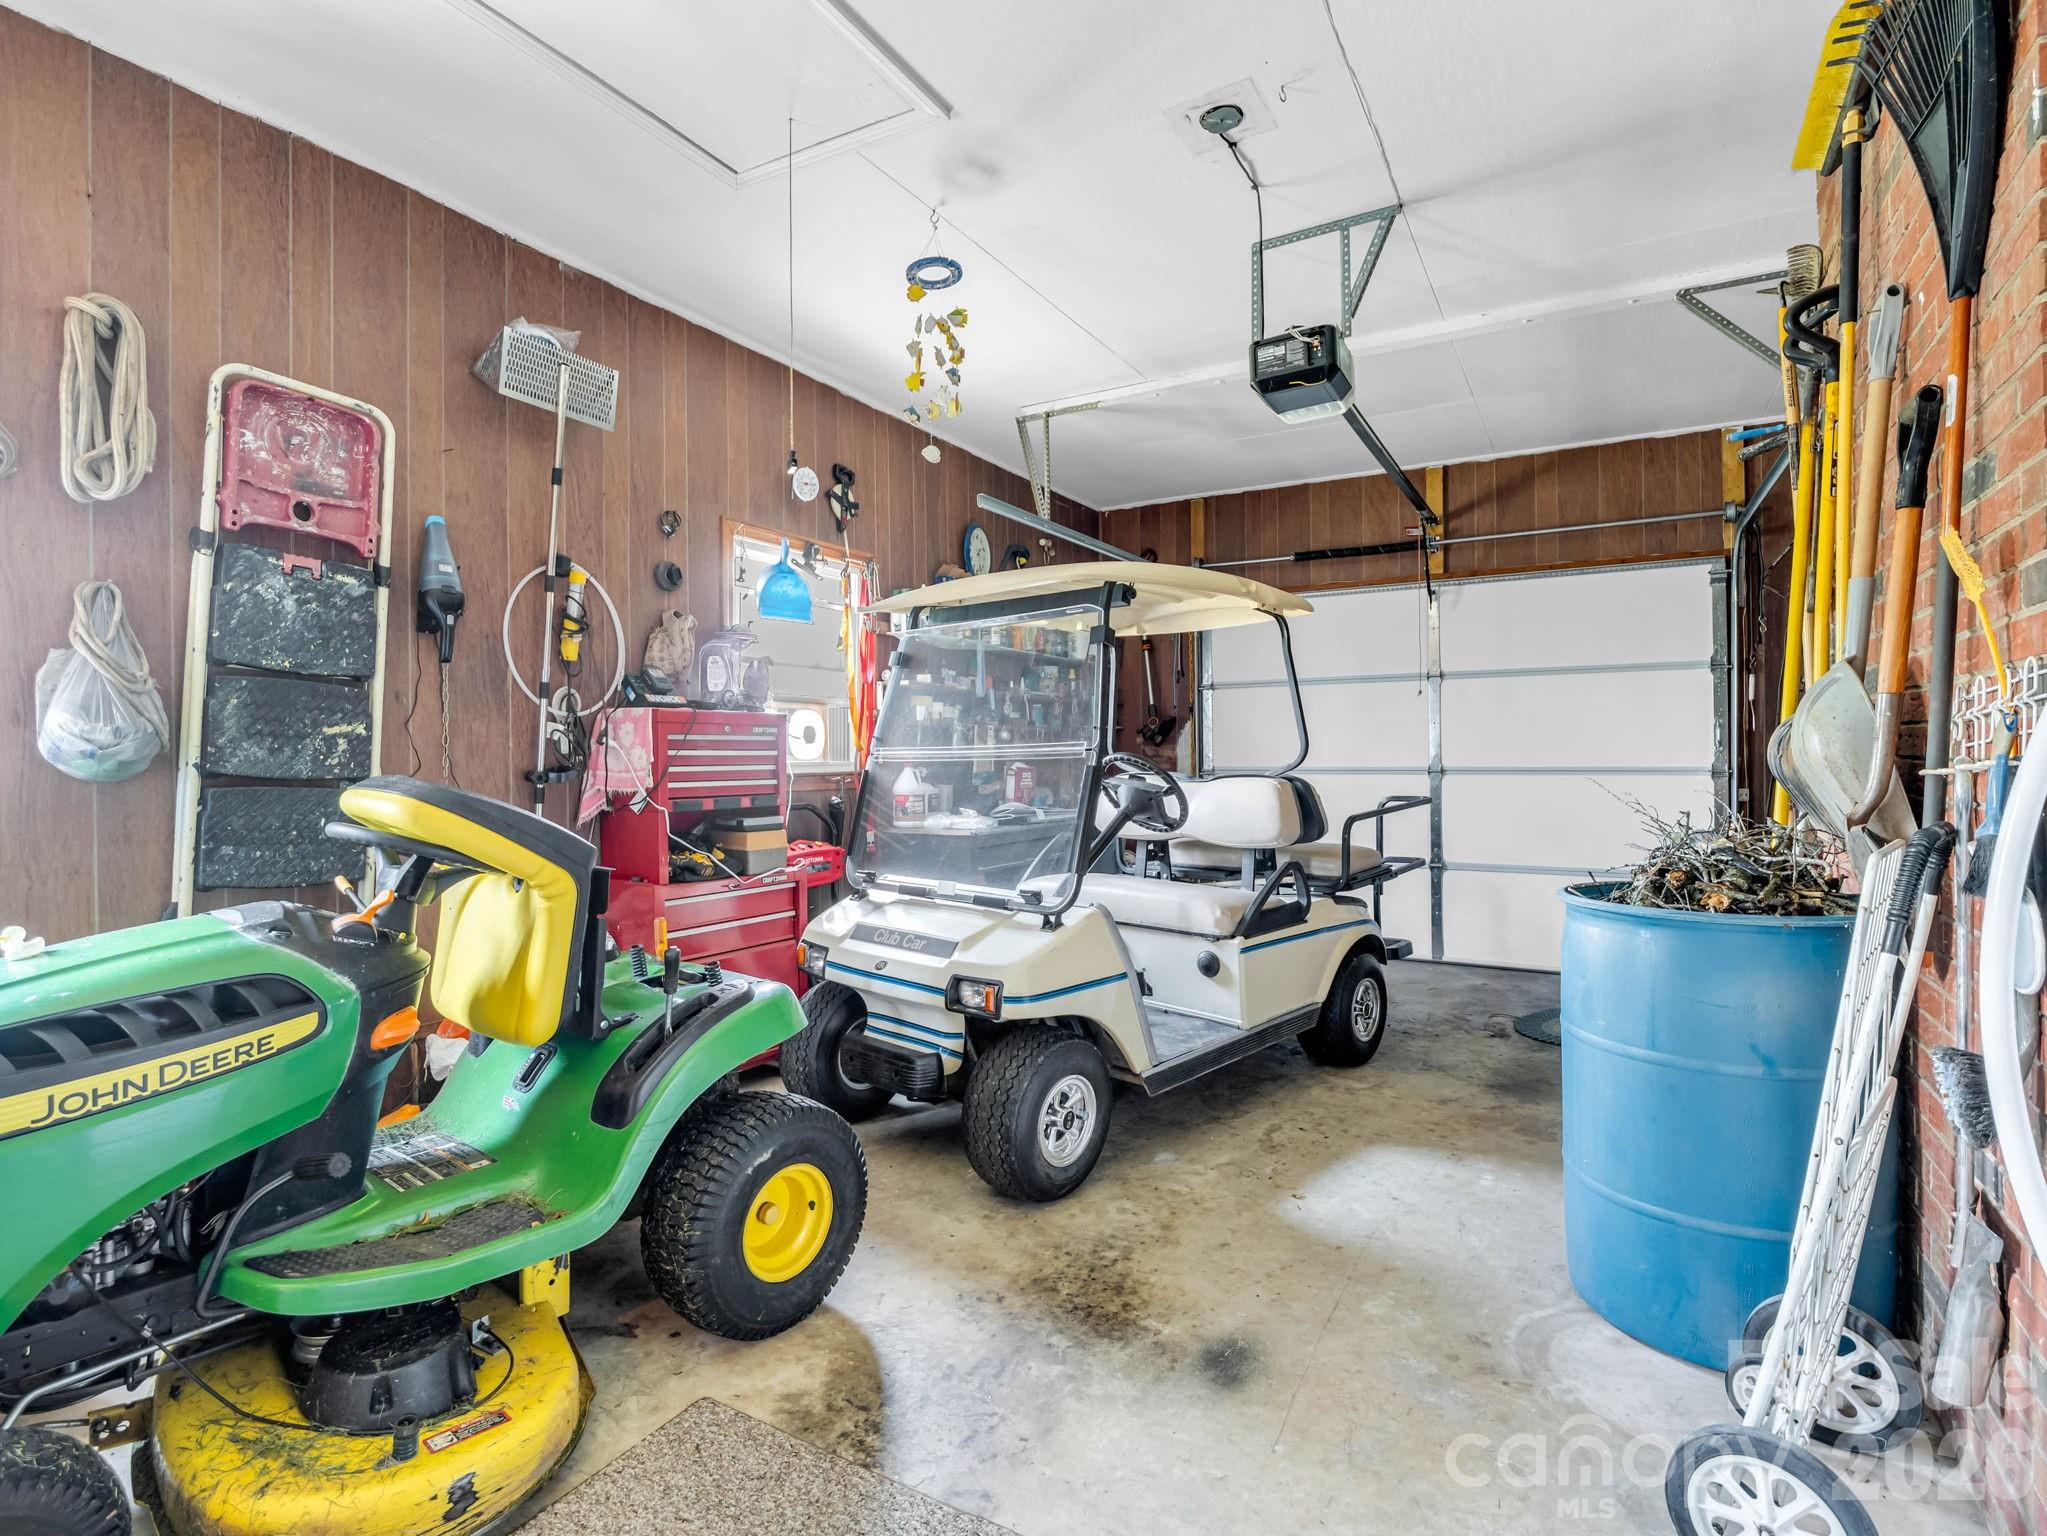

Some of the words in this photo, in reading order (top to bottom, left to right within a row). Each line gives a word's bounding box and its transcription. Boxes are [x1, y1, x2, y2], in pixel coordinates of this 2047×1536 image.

[752, 726, 778, 734] CRAFTSMAN
[762, 875, 788, 884] CRAFTSMAN
[873, 929, 900, 945] Club
[902, 933, 927, 950] Car
[30, 1073, 149, 1125] JOHN
[158, 1033, 275, 1088] DEERE
